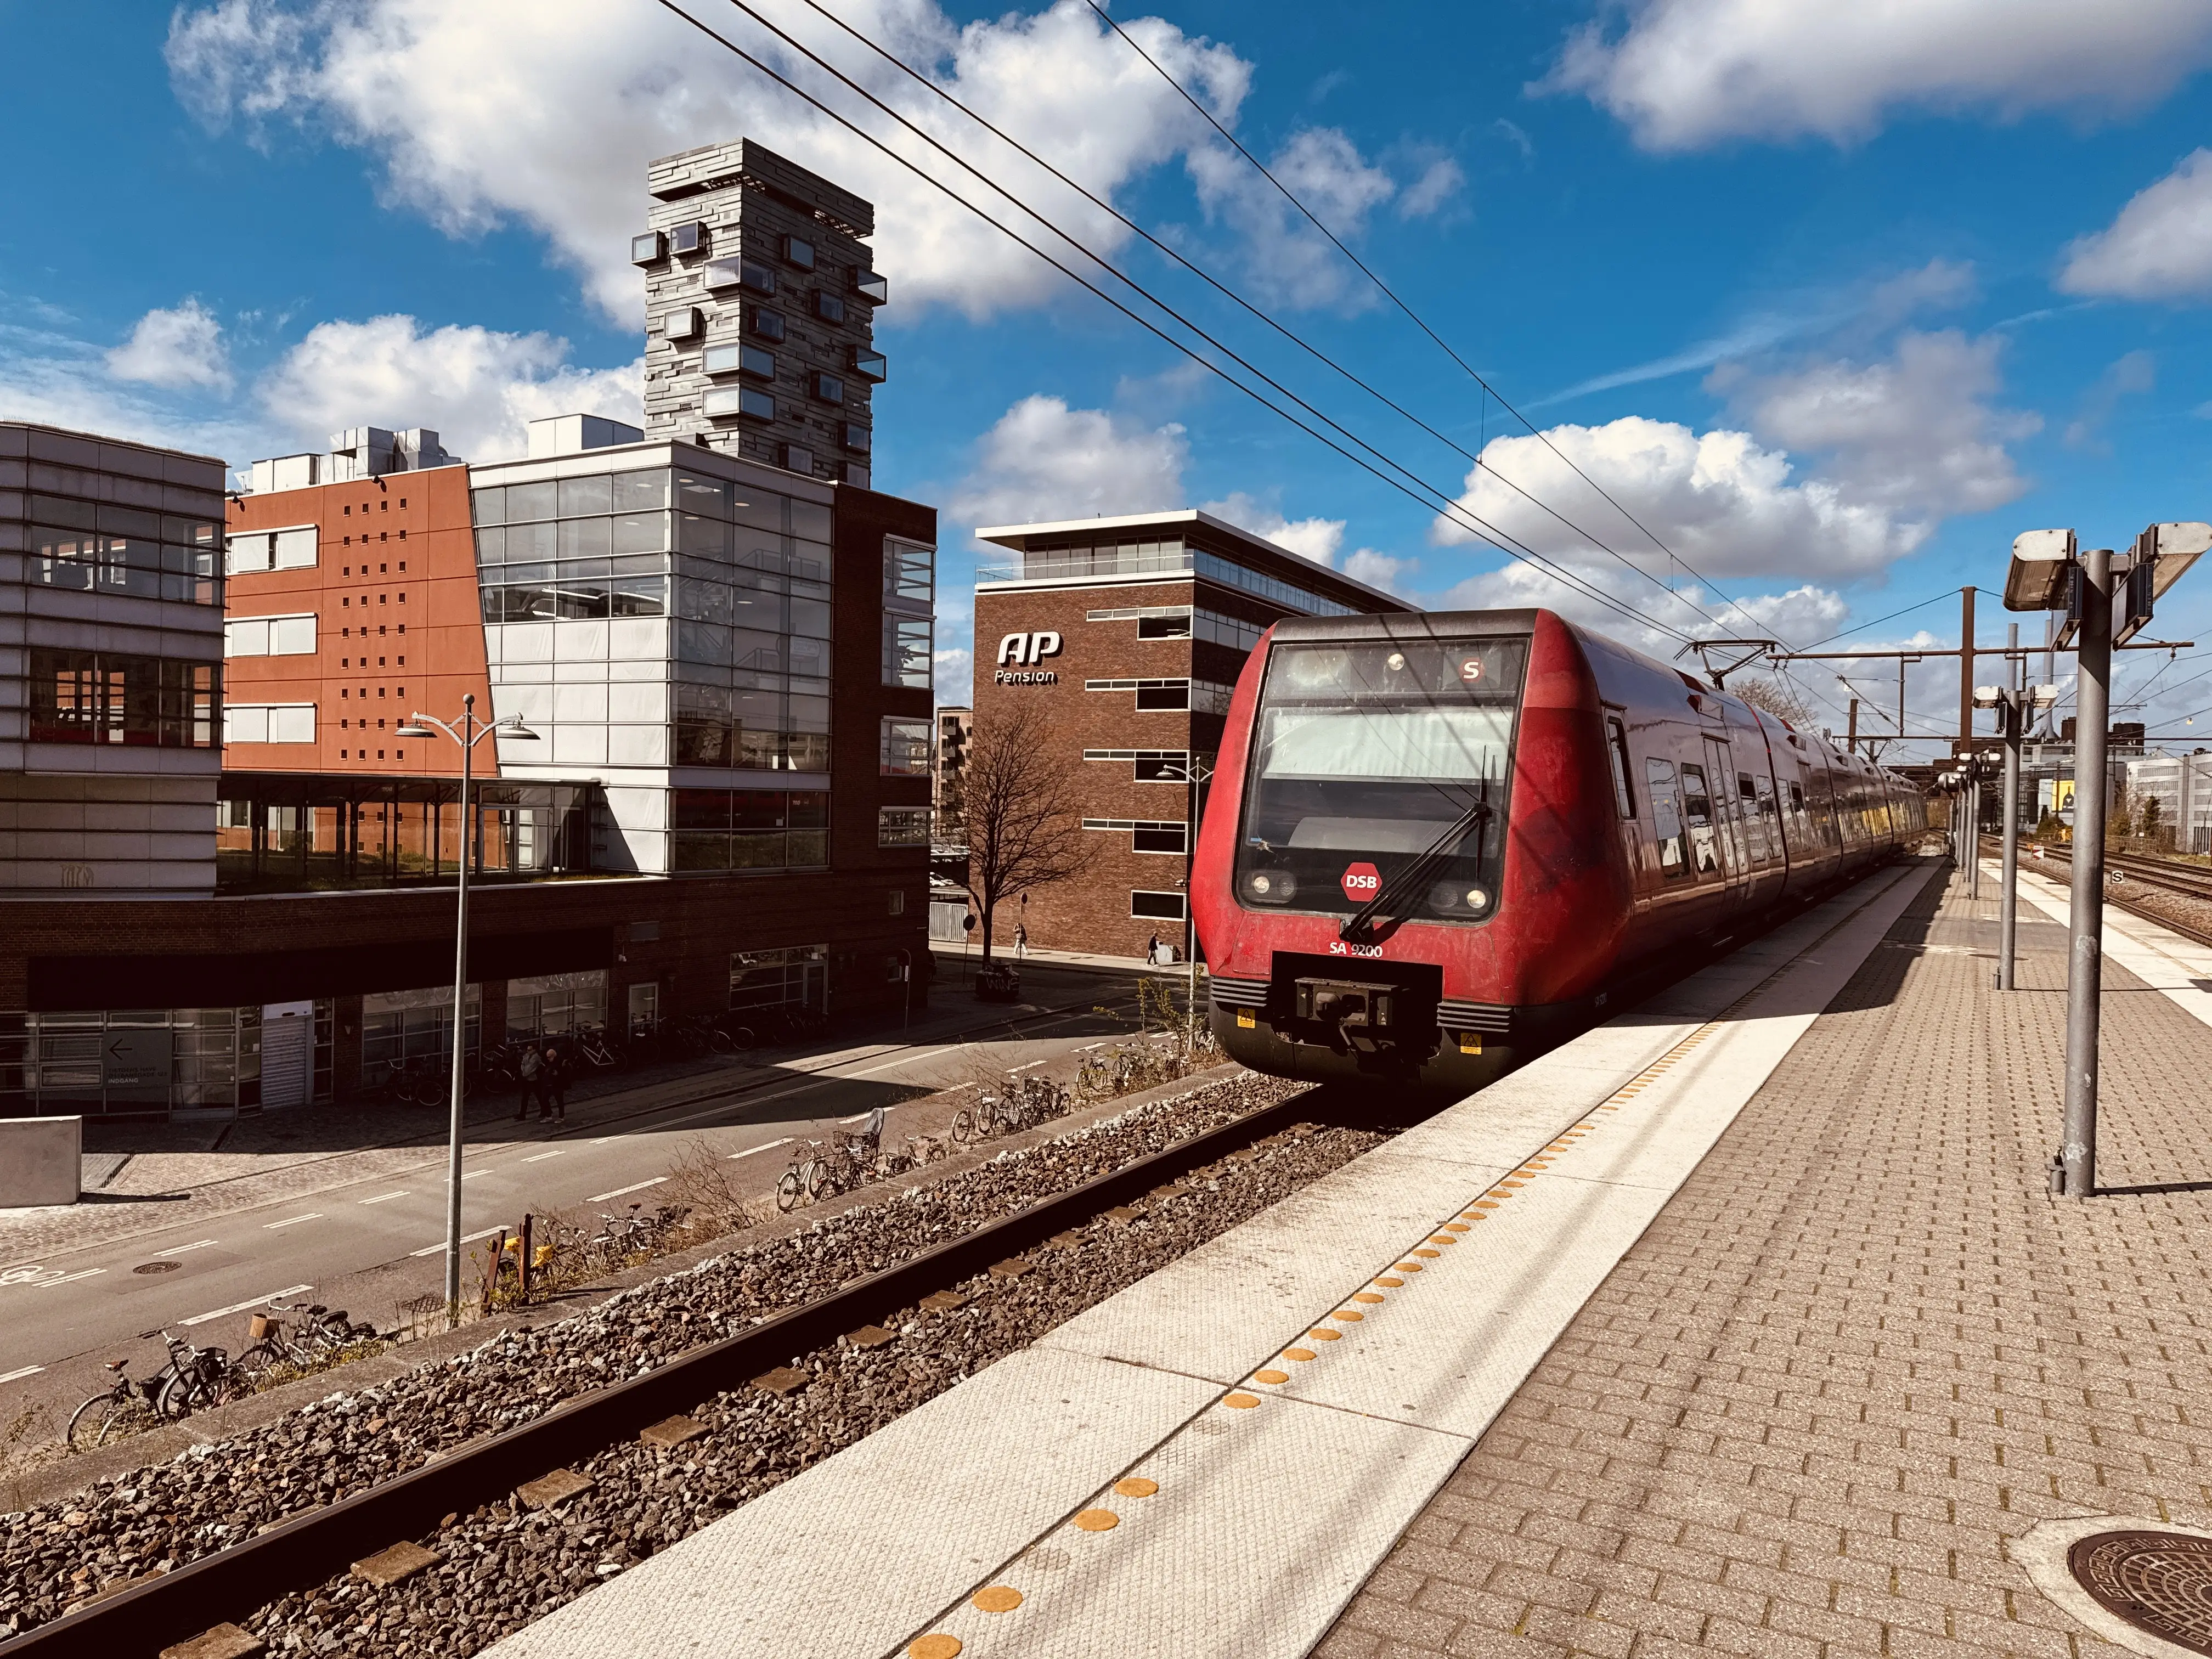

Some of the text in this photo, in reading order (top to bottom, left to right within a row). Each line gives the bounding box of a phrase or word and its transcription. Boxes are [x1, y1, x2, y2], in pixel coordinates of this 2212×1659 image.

[997, 631, 1060, 663] AP
[994, 670, 1054, 683] Pension
[1463, 662, 1479, 679] S
[1346, 874, 1377, 889] DSB
[2113, 872, 2122, 882] S
[1329, 942, 1383, 958] SA 9200
